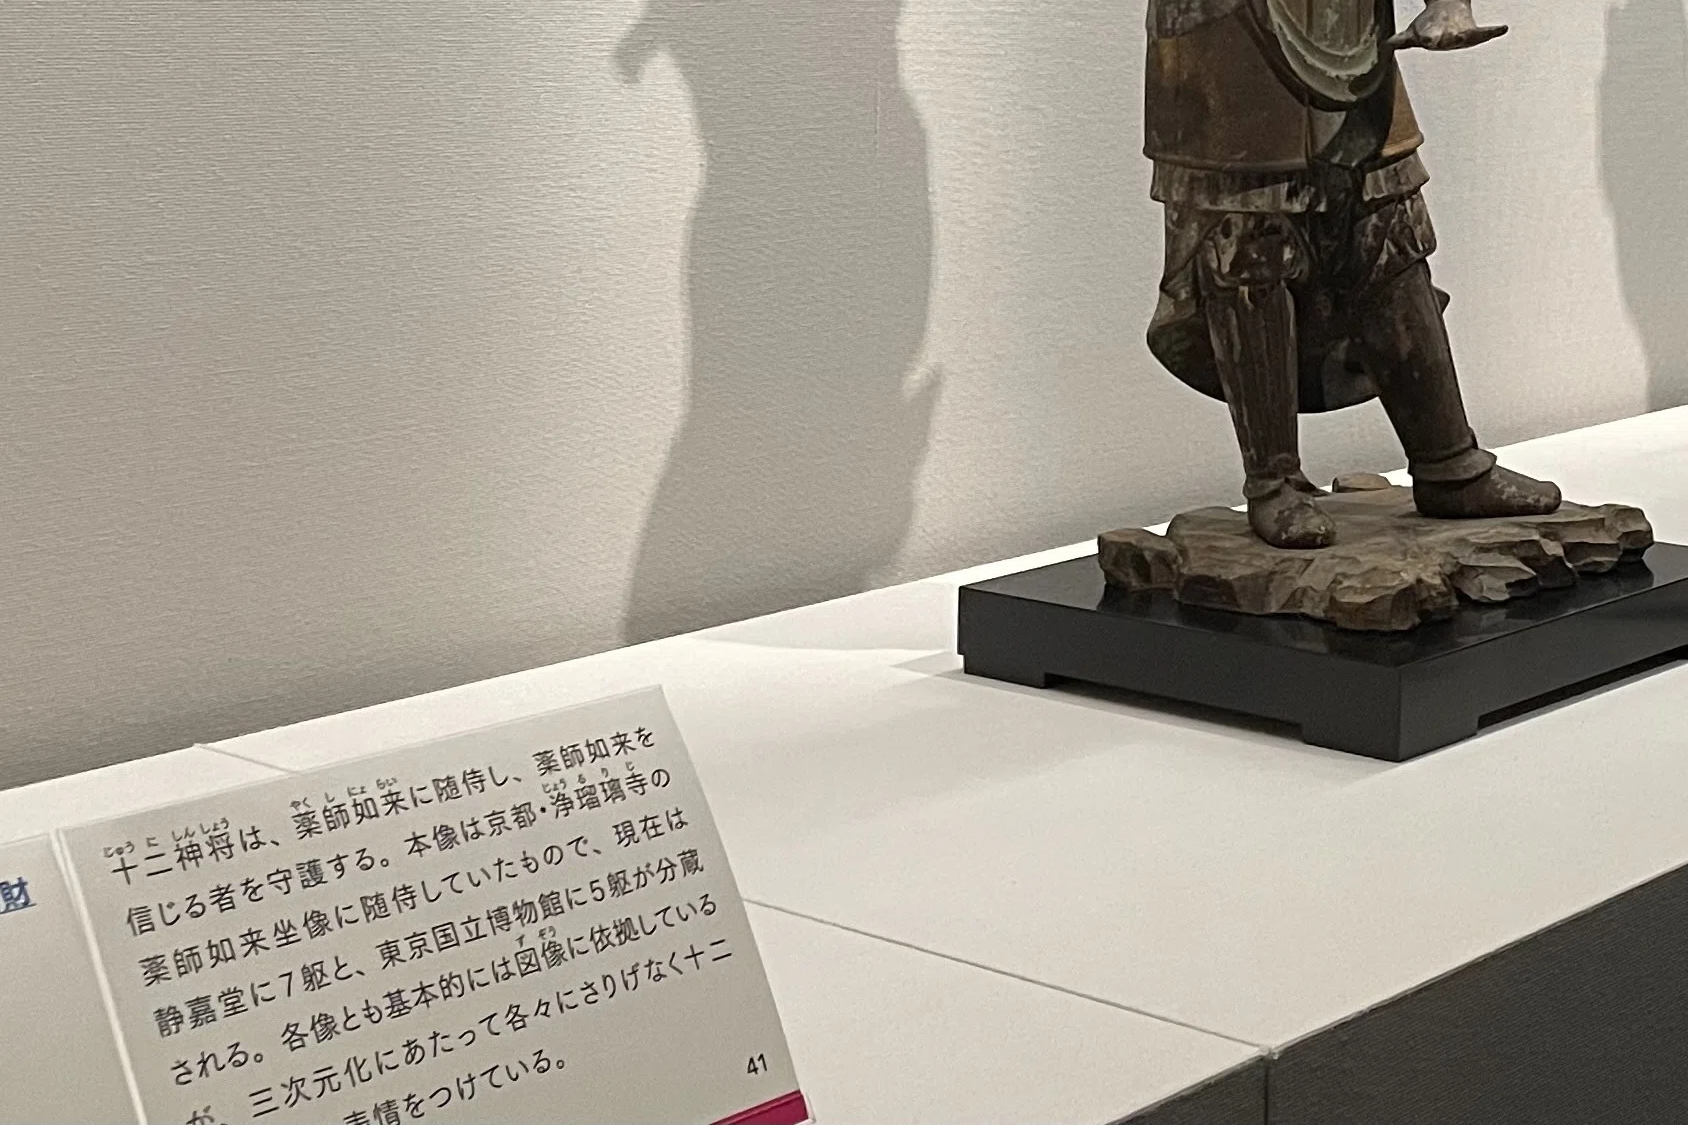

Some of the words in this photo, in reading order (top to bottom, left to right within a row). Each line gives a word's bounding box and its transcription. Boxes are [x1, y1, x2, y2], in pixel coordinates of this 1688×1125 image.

[0, 876, 31, 912] 財
[138, 806, 689, 988] 薬師如来坐像に随侍していたもので、現在は
[171, 893, 717, 1086] される。各像とも基本的には図像に依拠している
[186, 938, 733, 1125] が三次元化にあたって各々にさりげなく十二
[746, 1053, 768, 1075] 41
